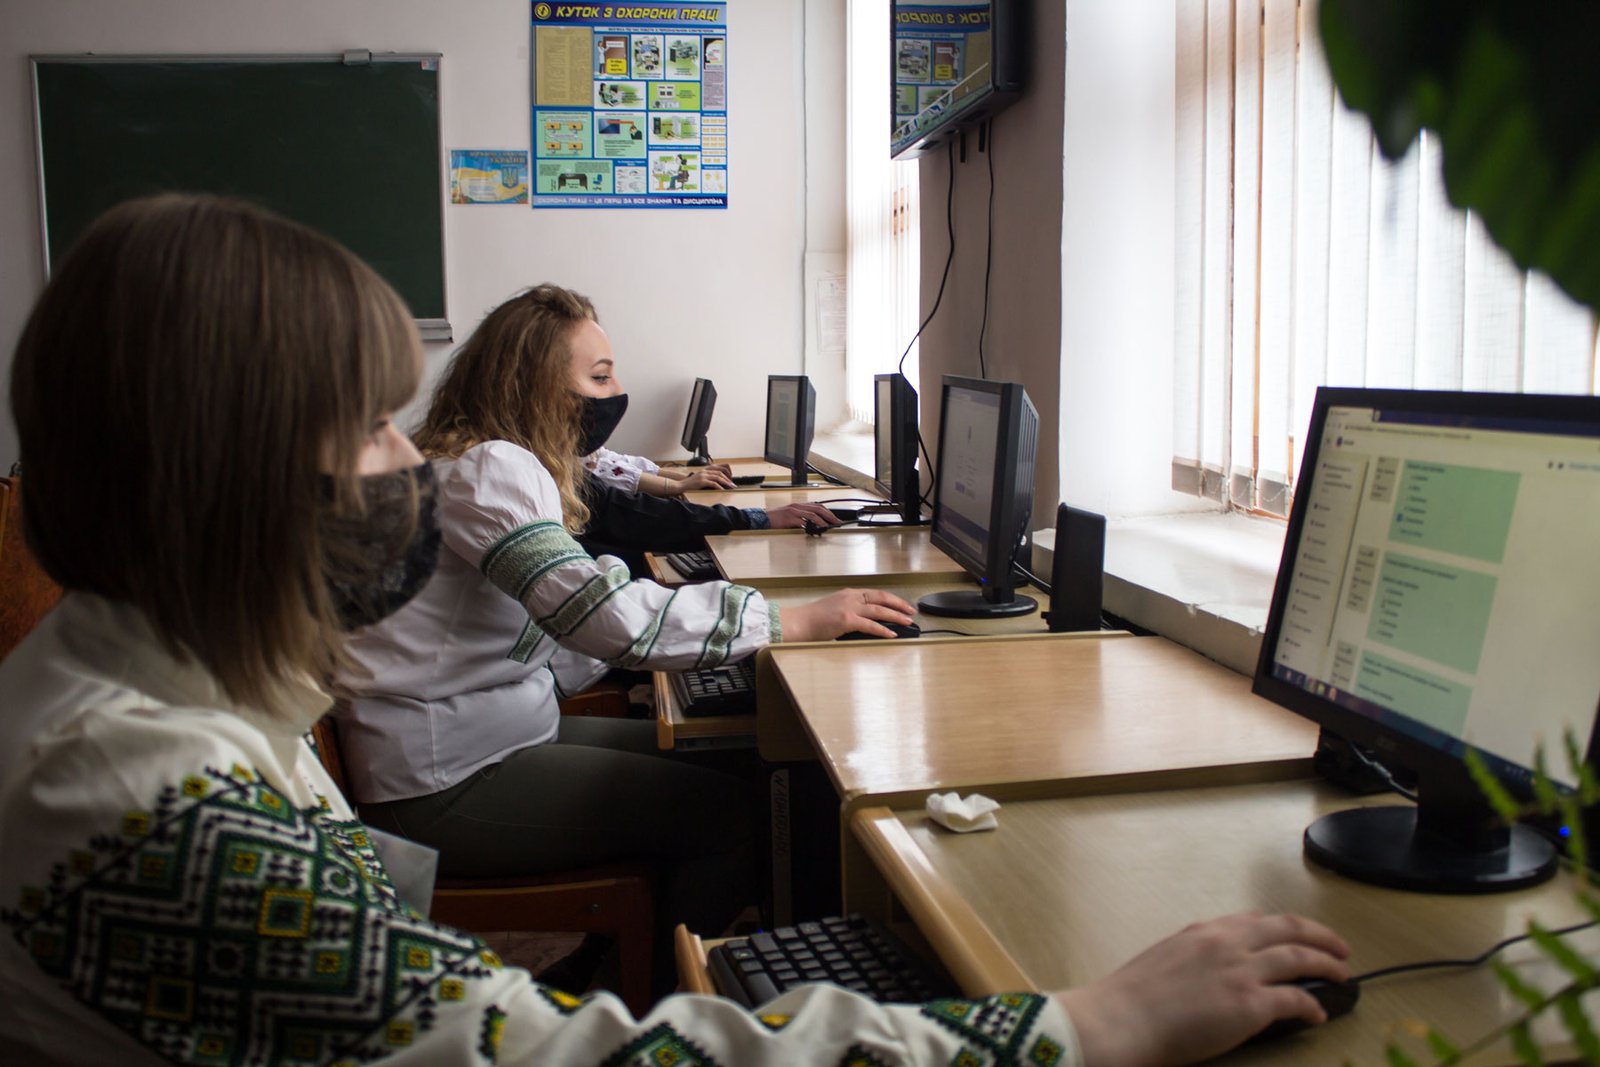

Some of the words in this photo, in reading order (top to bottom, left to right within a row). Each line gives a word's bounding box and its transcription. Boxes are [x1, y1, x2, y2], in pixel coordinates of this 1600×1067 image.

[555, 6, 601, 18] КУТОК
[615, 7, 678, 19] ОХОРОНИ
[680, 8, 720, 21] ПРАЦІ
